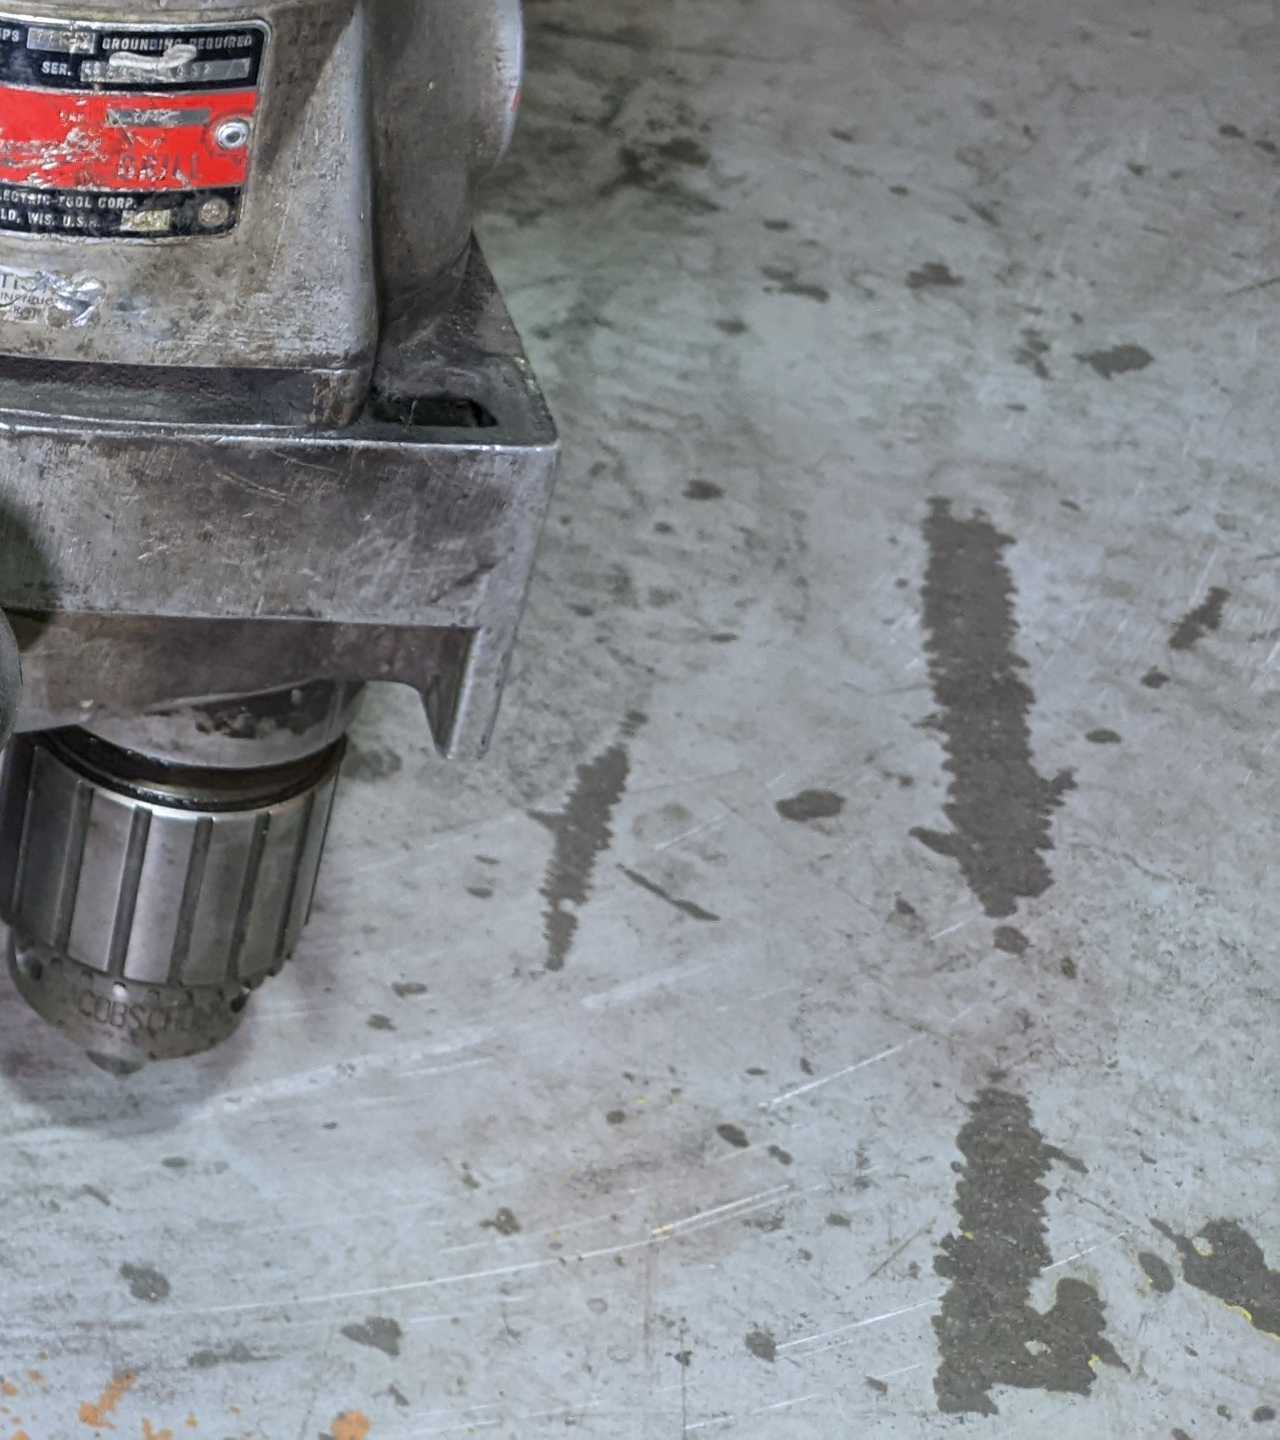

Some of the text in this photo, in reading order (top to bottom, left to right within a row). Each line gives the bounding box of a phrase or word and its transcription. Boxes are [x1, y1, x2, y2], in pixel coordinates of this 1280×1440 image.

[41, 62, 72, 76] SER.
[97, 196, 137, 209] CORP.
[27, 210, 56, 226] WIS.
